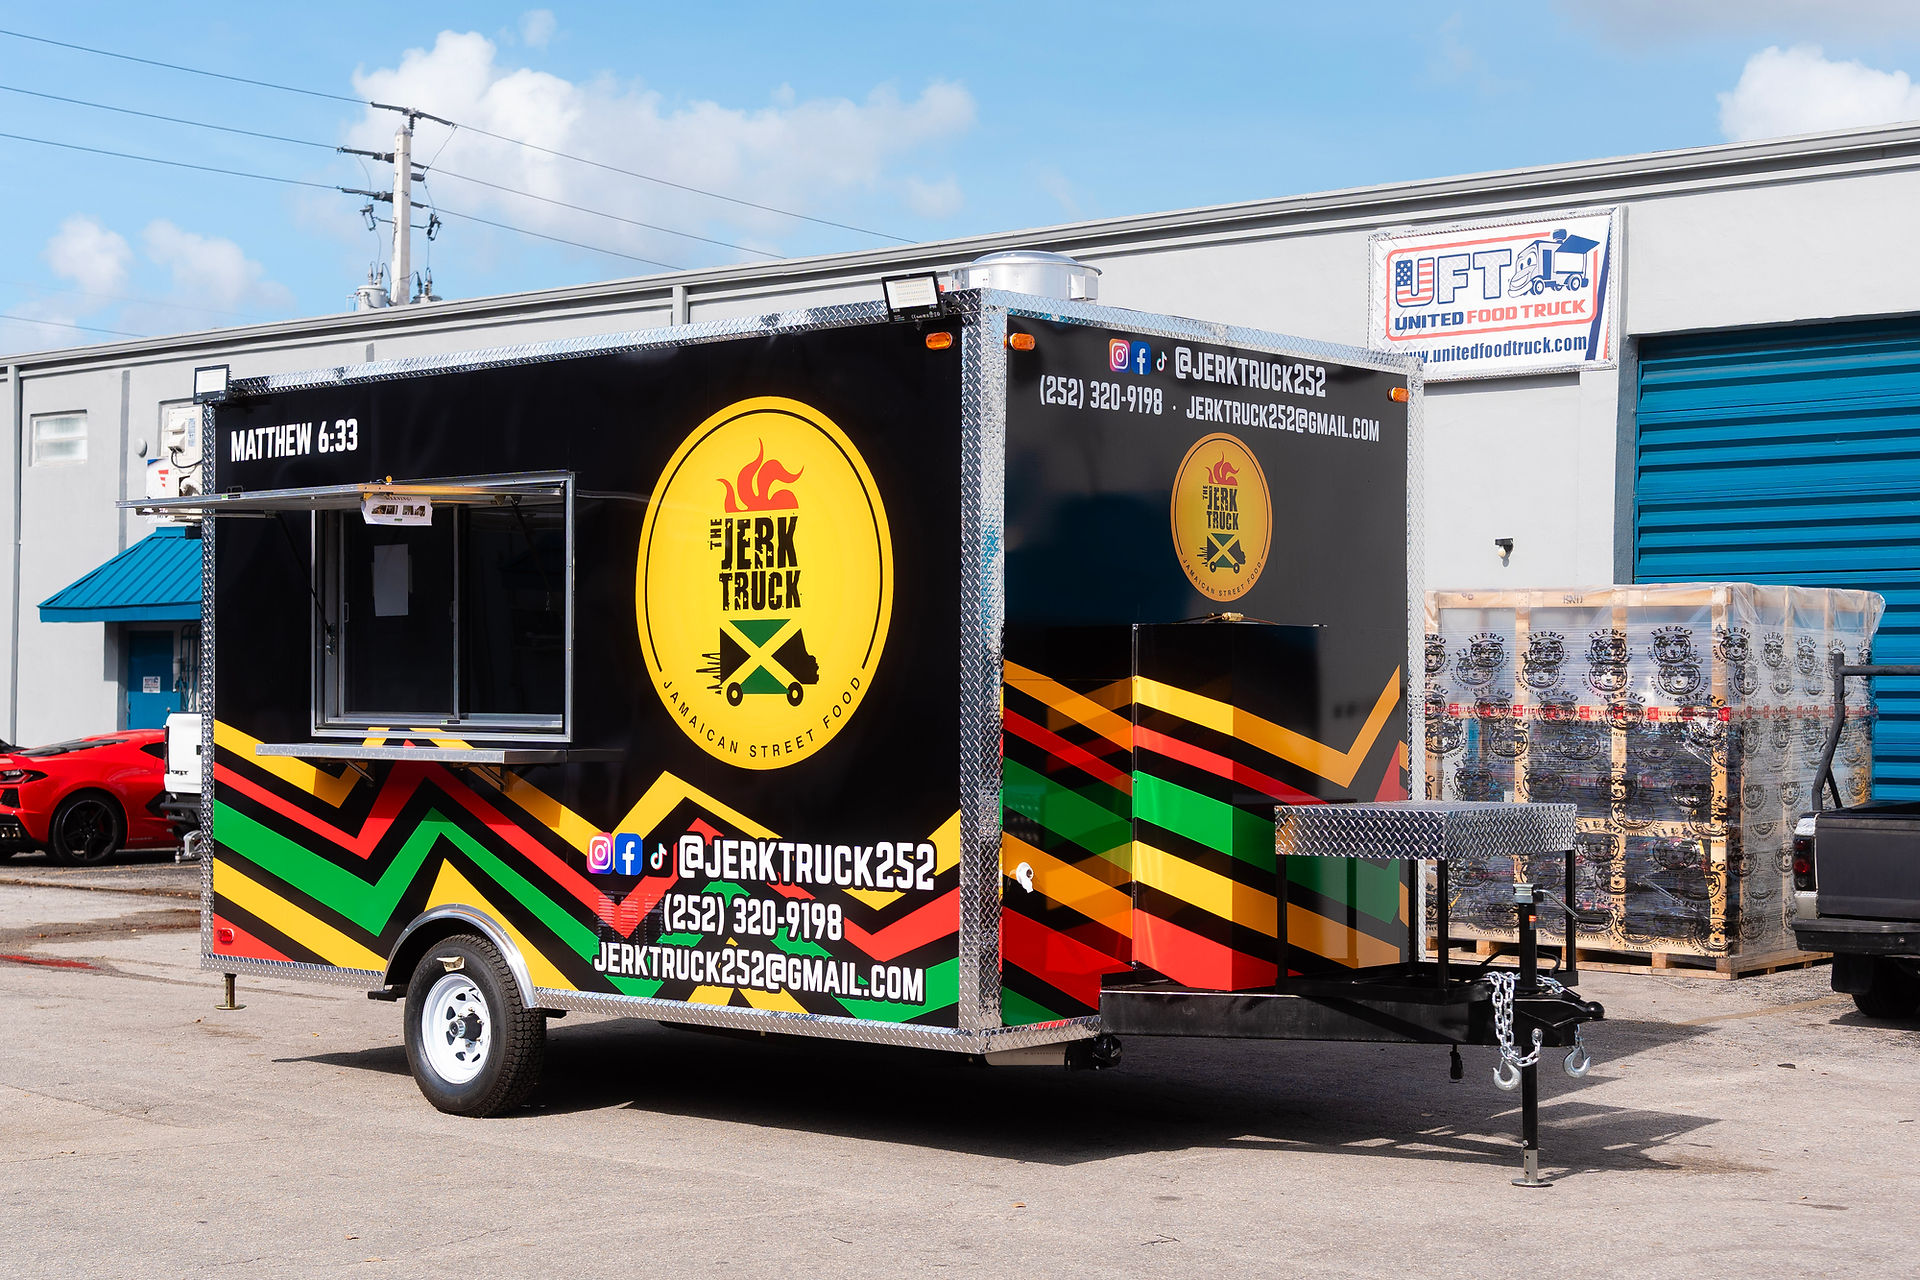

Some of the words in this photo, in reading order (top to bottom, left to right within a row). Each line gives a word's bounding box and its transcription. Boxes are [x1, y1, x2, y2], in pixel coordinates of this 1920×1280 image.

[1395, 248, 1512, 308] UFT
[1395, 311, 1464, 331] UNITED
[1466, 305, 1518, 324] FOOD
[1521, 298, 1586, 319] TRUCK
[1402, 335, 1587, 363] w.unitedfoodtruck.com
[1175, 346, 1326, 398] @JERKTRUCK252
[1039, 374, 1084, 410] (252)
[1090, 380, 1163, 416] 320-9198
[1186, 395, 1380, 442] JERKTRUCK252@GMAIL.COM
[230, 421, 312, 463] MATTHEW
[318, 418, 359, 454] 6:33
[1206, 510, 1239, 531] TRUCK
[1207, 485, 1238, 512] JERK
[709, 518, 722, 550] THE
[721, 515, 799, 571] JERK
[718, 570, 801, 611] TRUCK
[1182, 559, 1215, 595] JAMAICAN
[1218, 584, 1244, 597] STREET
[1246, 561, 1262, 585] FOOD
[1651, 625, 1693, 637] FIERO
[663, 680, 739, 754] JAMAICAN
[749, 729, 815, 758] STREET
[823, 676, 861, 730] FOOD
[678, 834, 935, 891] @JERKTRUCK252
[663, 893, 725, 935] (252)
[733, 897, 842, 940] 320-9198
[593, 942, 925, 1003] JERKTRUCK252@GMAIL.COM
